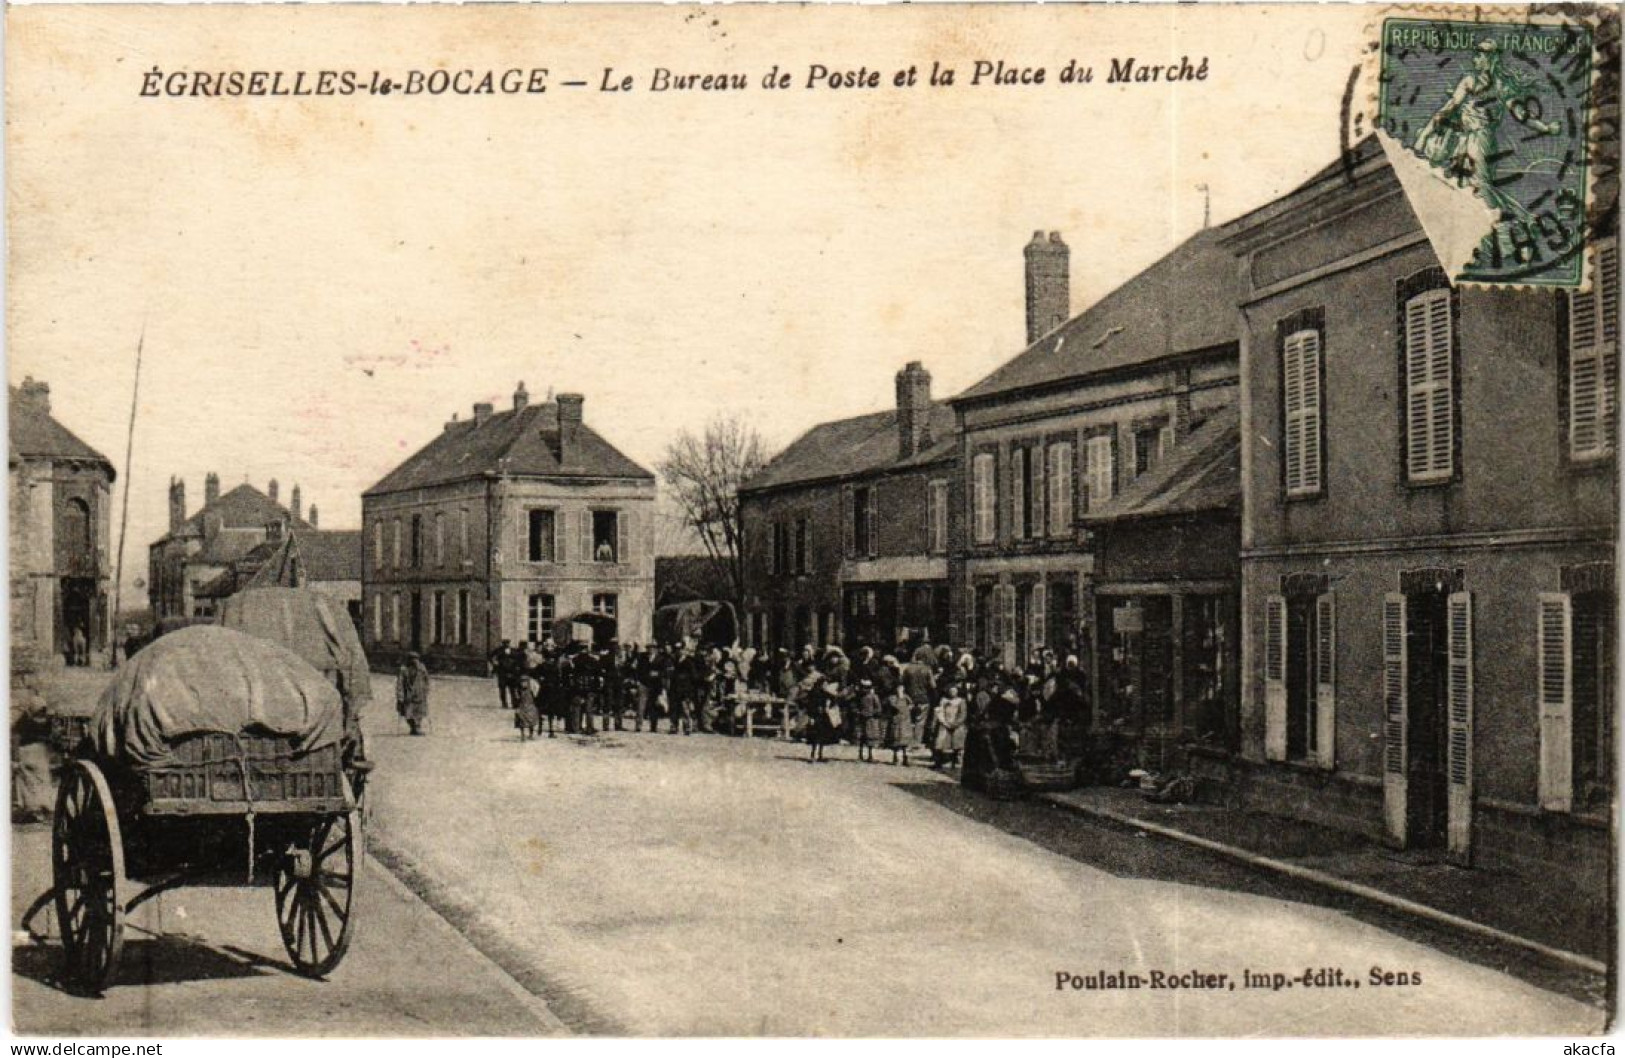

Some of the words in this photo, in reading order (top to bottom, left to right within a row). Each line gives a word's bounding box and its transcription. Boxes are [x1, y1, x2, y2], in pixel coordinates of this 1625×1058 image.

[138, 66, 550, 97] ÉGRISELLES-le-BOCAGE
[599, 67, 634, 93] Le
[650, 68, 748, 92] Bureau
[760, 65, 792, 90] de
[805, 64, 881, 90] Poste
[892, 66, 918, 88] et
[928, 61, 956, 88] la
[970, 60, 1046, 87] Place
[1058, 59, 1093, 85] du
[1106, 56, 1210, 85] Marché
[1055, 969, 1236, 992] Poulain-Rocher,
[1243, 967, 1361, 991] imp.-édit.,
[1368, 967, 1422, 987] Sens
